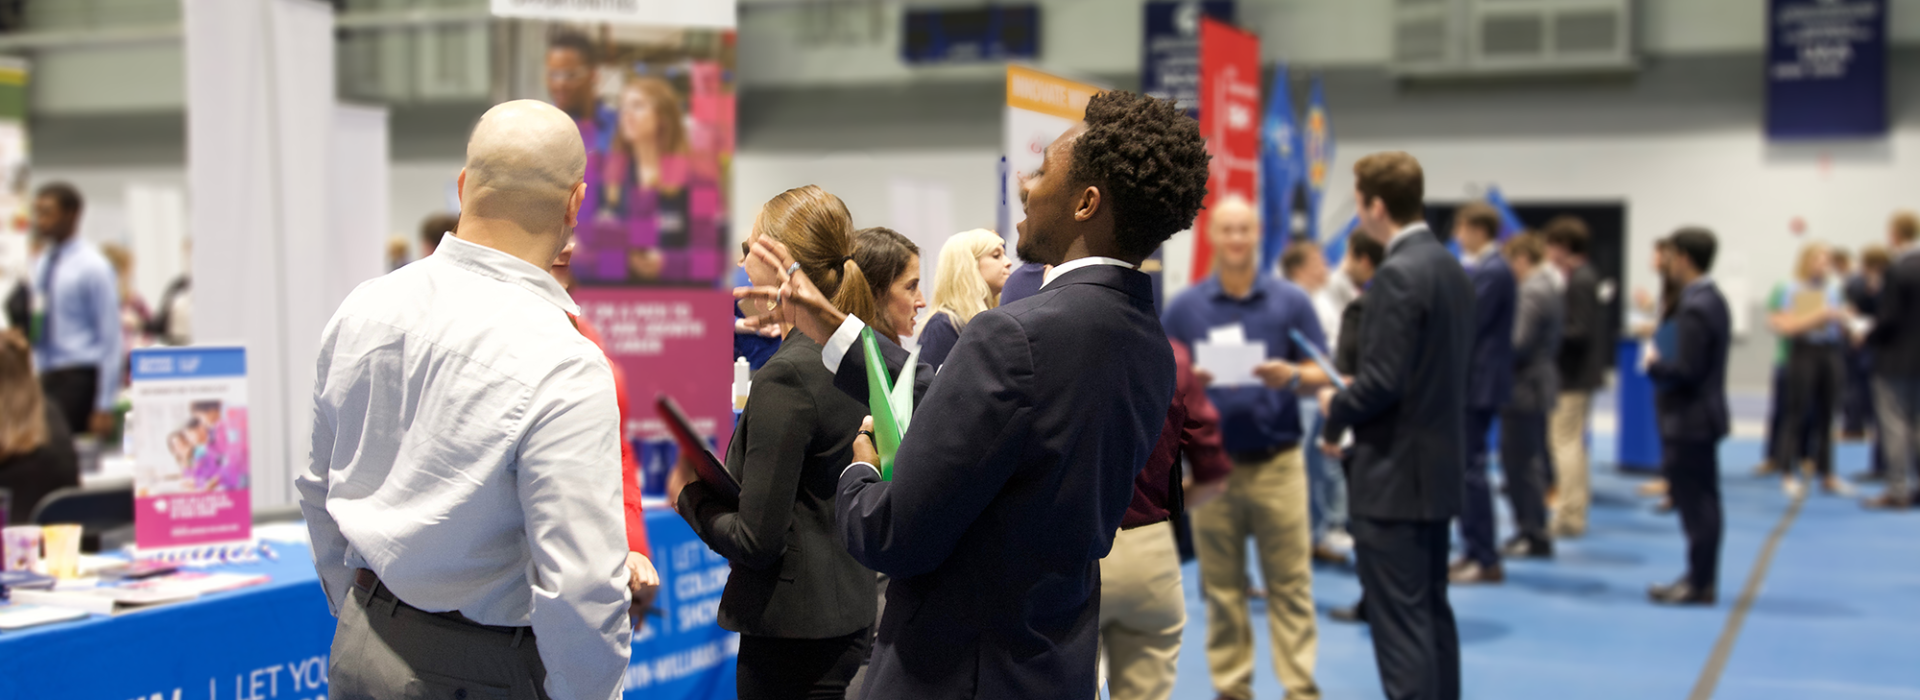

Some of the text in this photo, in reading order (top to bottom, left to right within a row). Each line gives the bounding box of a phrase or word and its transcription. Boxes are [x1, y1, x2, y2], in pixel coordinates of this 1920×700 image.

[1012, 74, 1067, 108] INNOVATE
[236, 655, 328, 700] LET YOU
